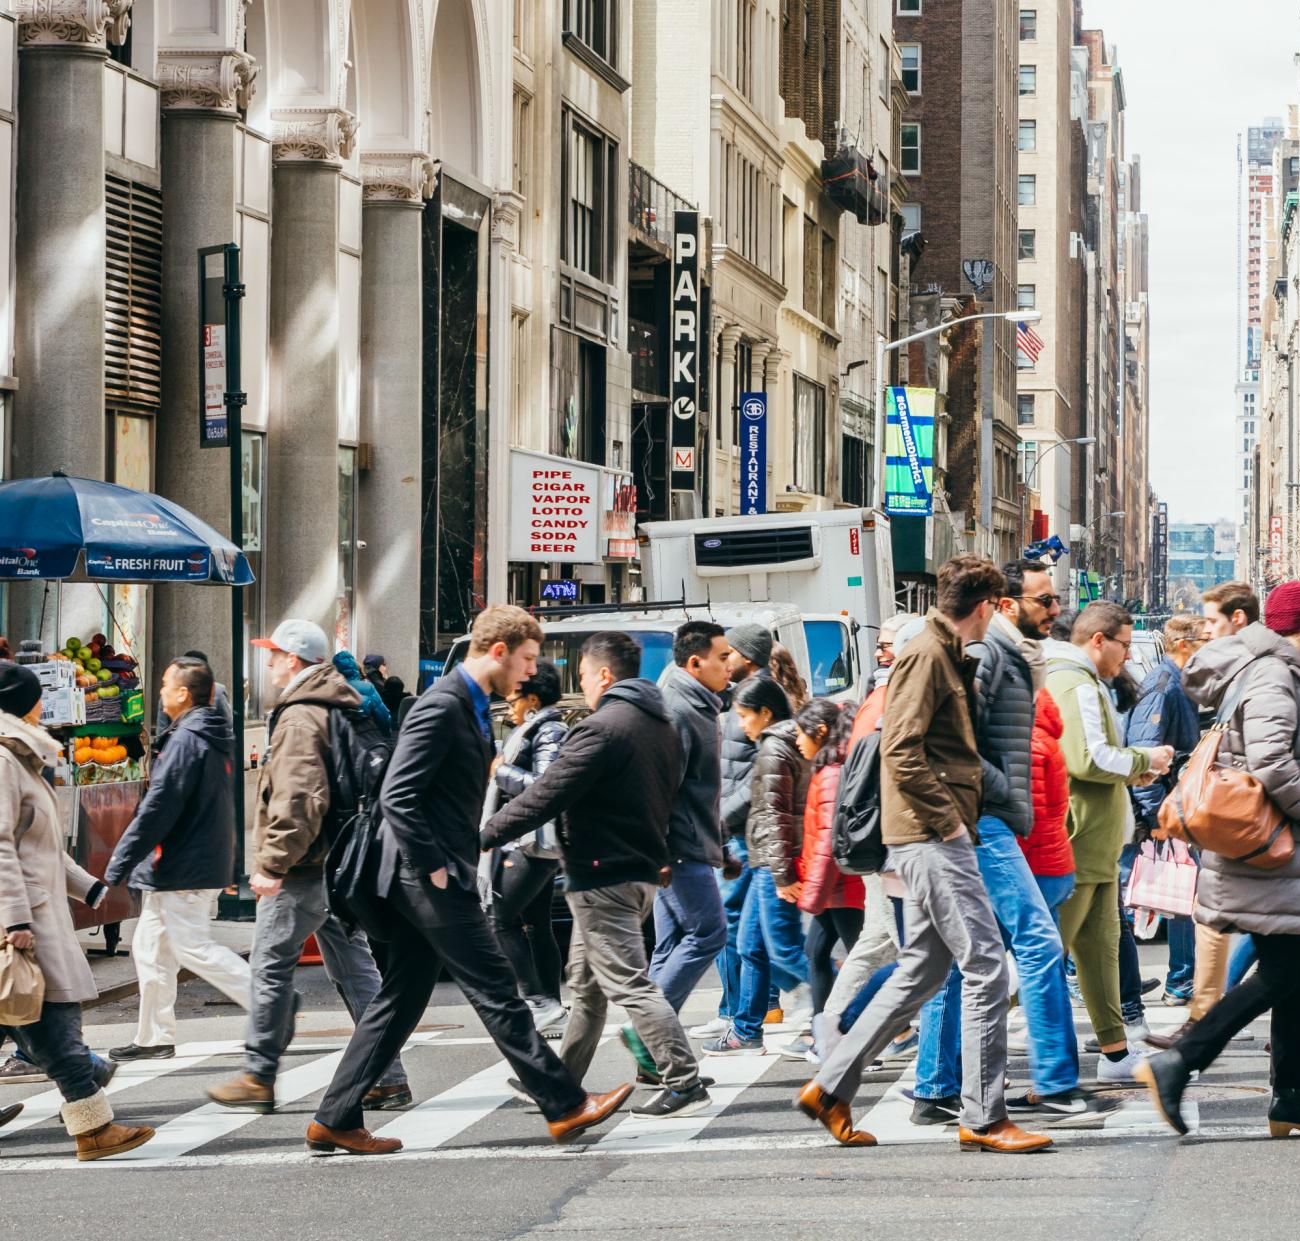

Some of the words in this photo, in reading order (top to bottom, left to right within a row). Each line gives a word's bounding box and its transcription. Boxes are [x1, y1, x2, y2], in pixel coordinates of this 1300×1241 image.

[674, 233, 696, 383] PARK
[896, 395, 922, 485] #GarmentDistrict
[747, 425, 759, 504] RESTAURANT
[532, 471, 572, 479] PIPE
[532, 483, 585, 491] CIGAR
[532, 495, 590, 504] VAPOR
[532, 507, 583, 515] LOTTO
[531, 520, 588, 528] CANDY
[531, 532, 578, 540] SODA
[531, 544, 575, 552] BEER
[115, 559, 151, 570] FRESH
[153, 559, 185, 571] FRUIT
[17, 568, 40, 576] Bank
[543, 584, 577, 598] ATM
